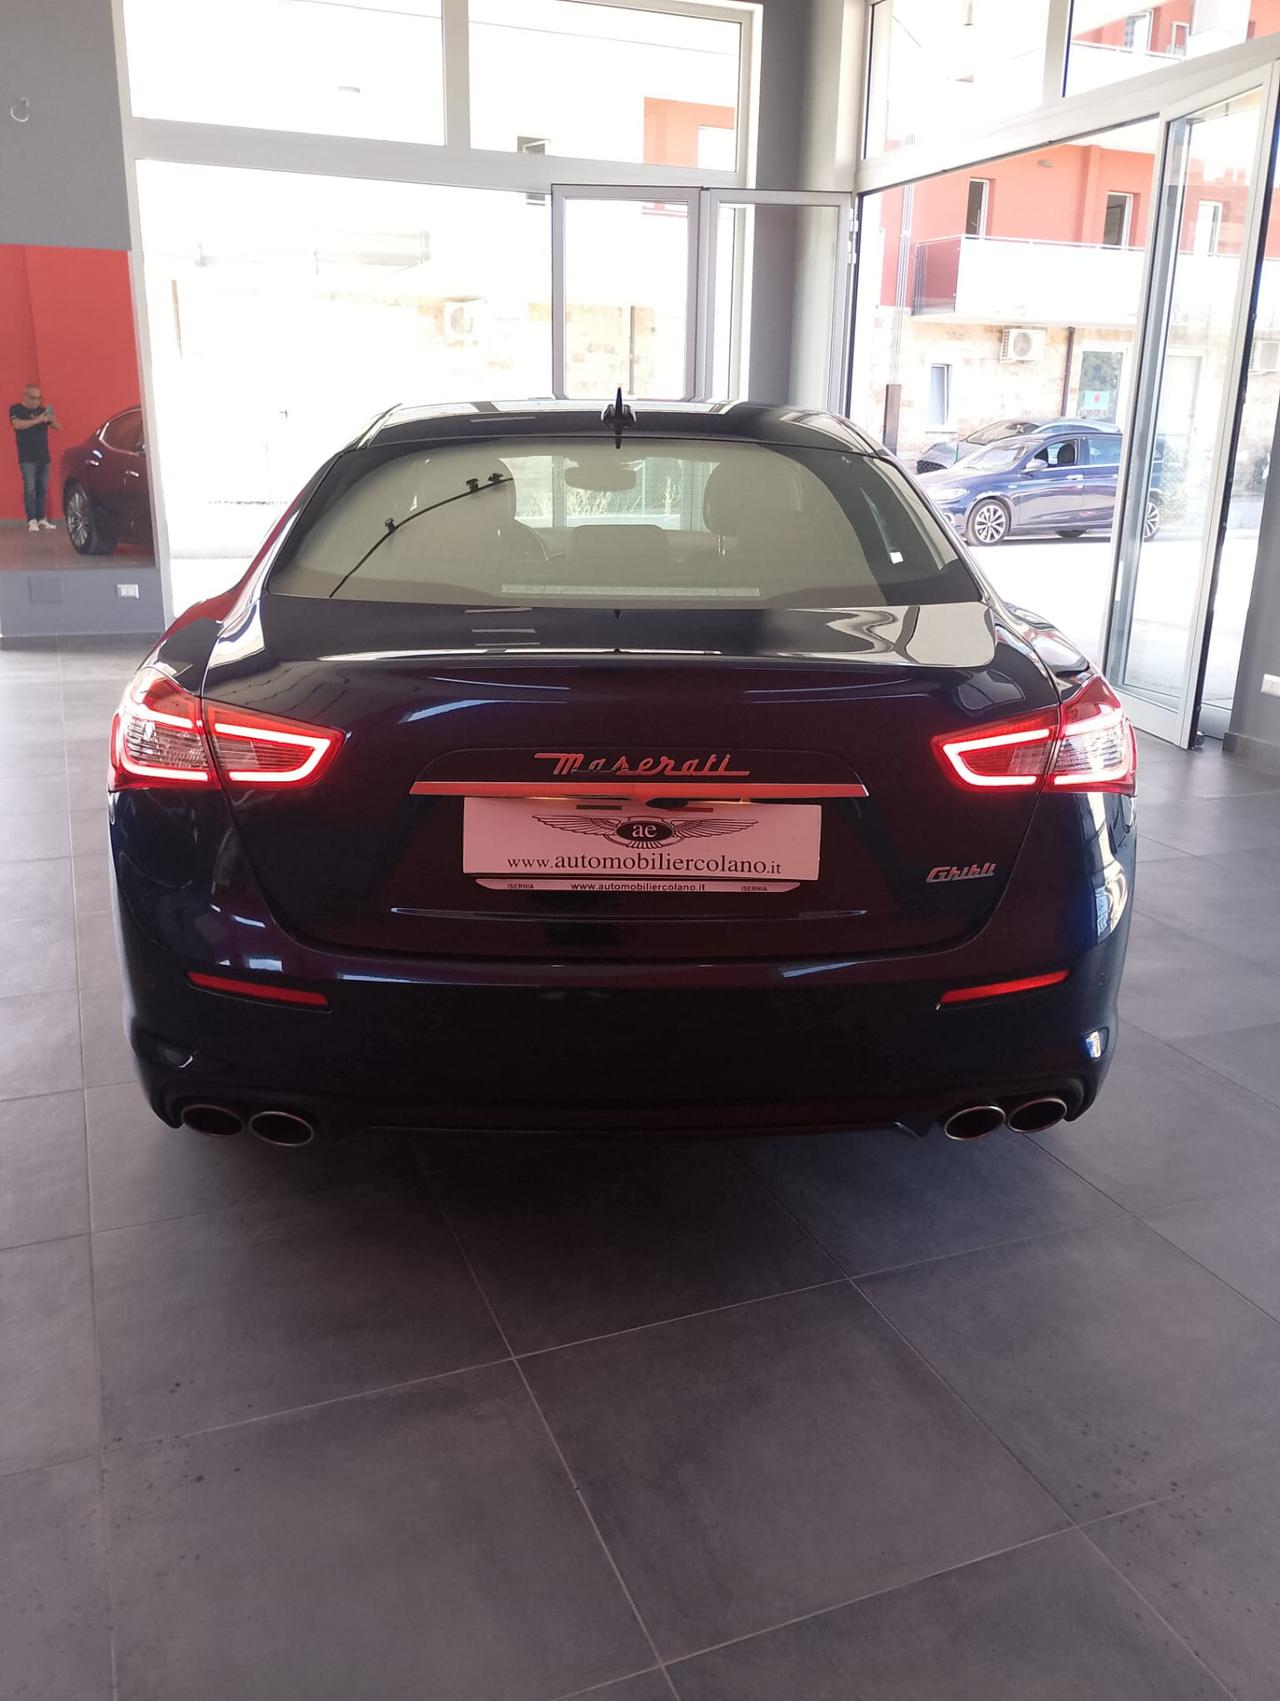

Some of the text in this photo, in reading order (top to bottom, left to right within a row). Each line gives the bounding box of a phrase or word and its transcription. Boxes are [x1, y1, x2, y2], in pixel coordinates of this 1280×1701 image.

[534, 752, 750, 776] Maserati
[631, 823, 658, 838] ae
[507, 852, 782, 874] www.automobiliercolano.it
[926, 862, 997, 883] Ghibli
[507, 882, 535, 890] ISERNIA
[570, 882, 706, 892] www.automobiliercolano.it
